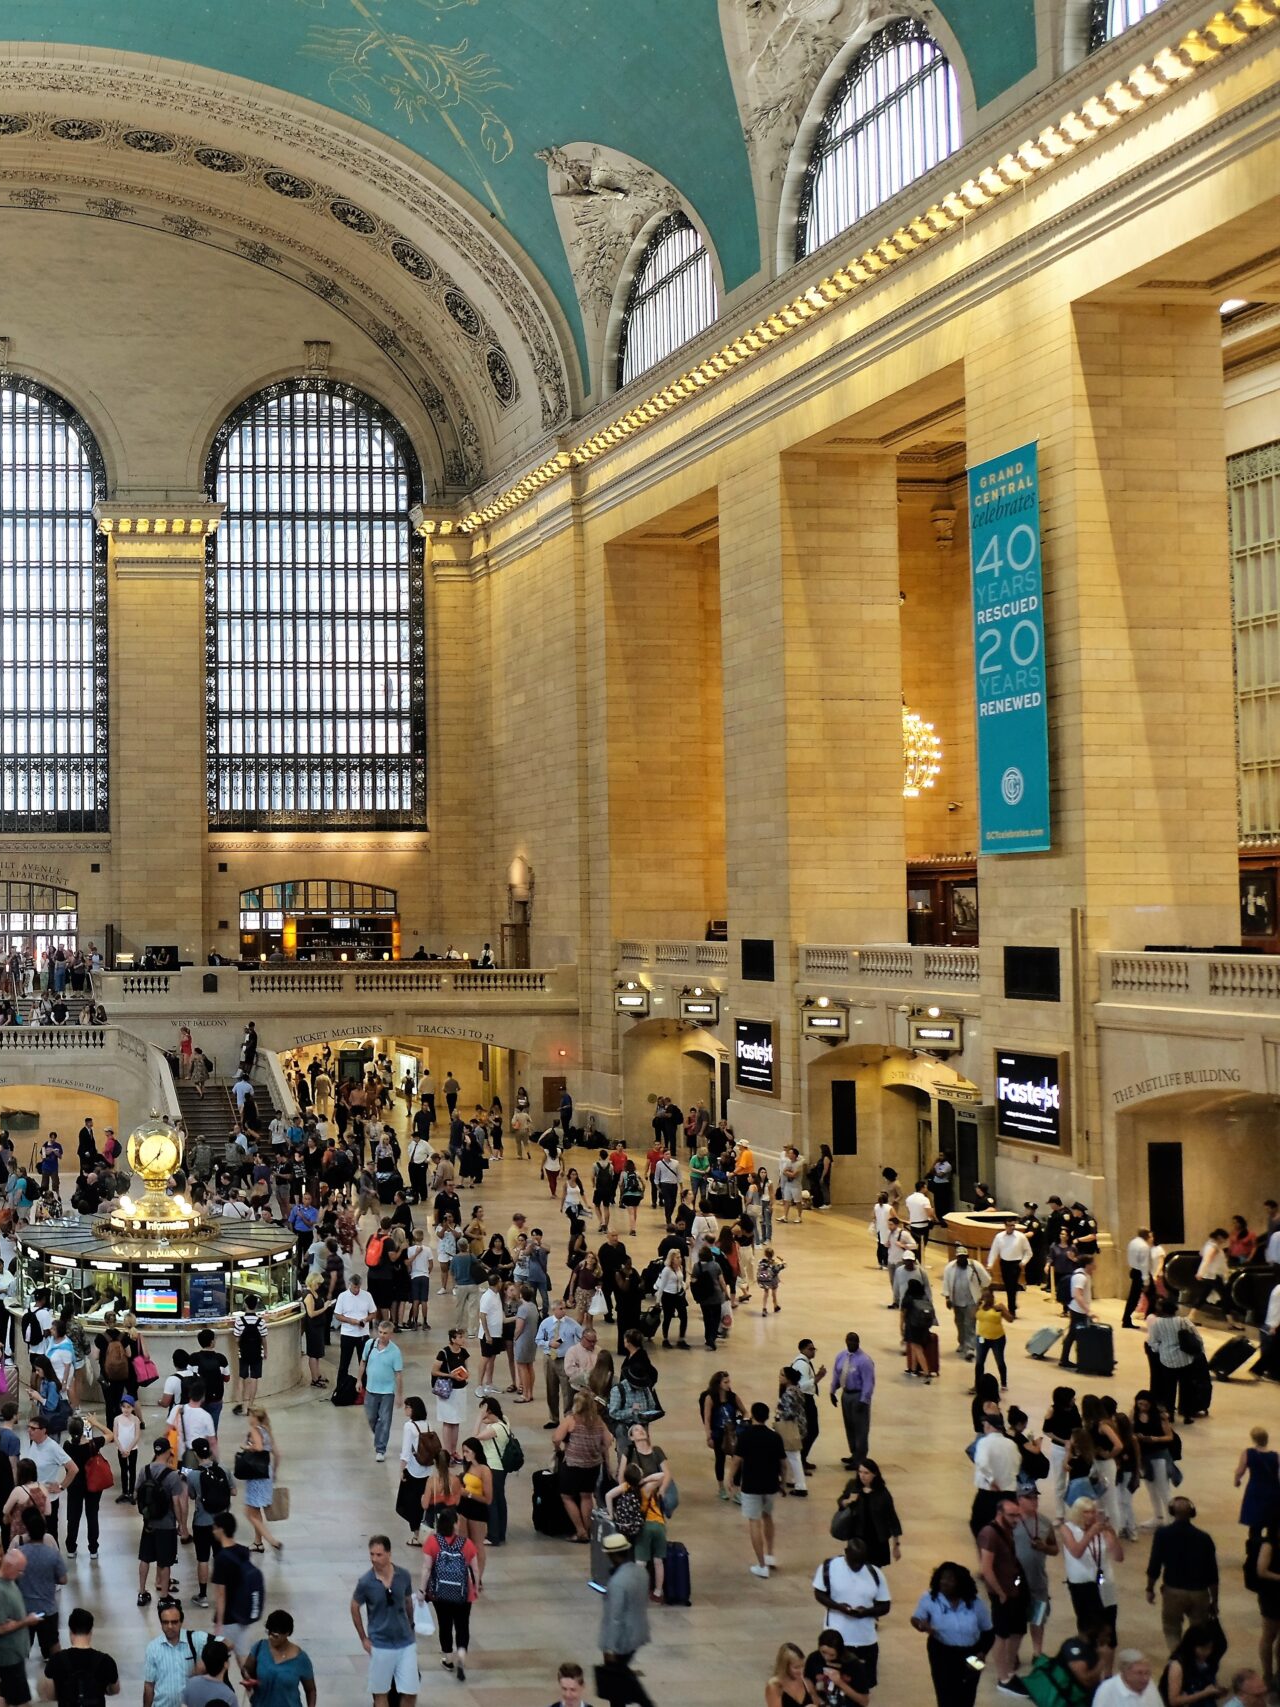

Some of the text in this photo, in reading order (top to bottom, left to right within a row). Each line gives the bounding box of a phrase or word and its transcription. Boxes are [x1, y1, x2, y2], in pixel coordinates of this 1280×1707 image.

[980, 462, 1024, 488] GRAND
[975, 475, 1033, 507] CENTRAL
[972, 492, 1036, 529] celebrates
[975, 524, 1036, 578] 40
[976, 571, 1037, 605] YEARS
[977, 595, 1038, 625] RESCUED
[979, 619, 1039, 674] 20
[979, 666, 1040, 697] YEARS
[980, 692, 1041, 717] RENEWED
[10, 871, 70, 886] APARTMENT
[22, 863, 62, 875] AVENUE
[193, 1019, 228, 1027] BALCONY
[293, 1024, 383, 1045] TICKET MACHINES
[417, 1025, 495, 1041] TRACKS 31 TO 42
[47, 1077, 73, 1087] TRACKS
[1112, 1068, 1240, 1104] THE METLIFE BUILDING
